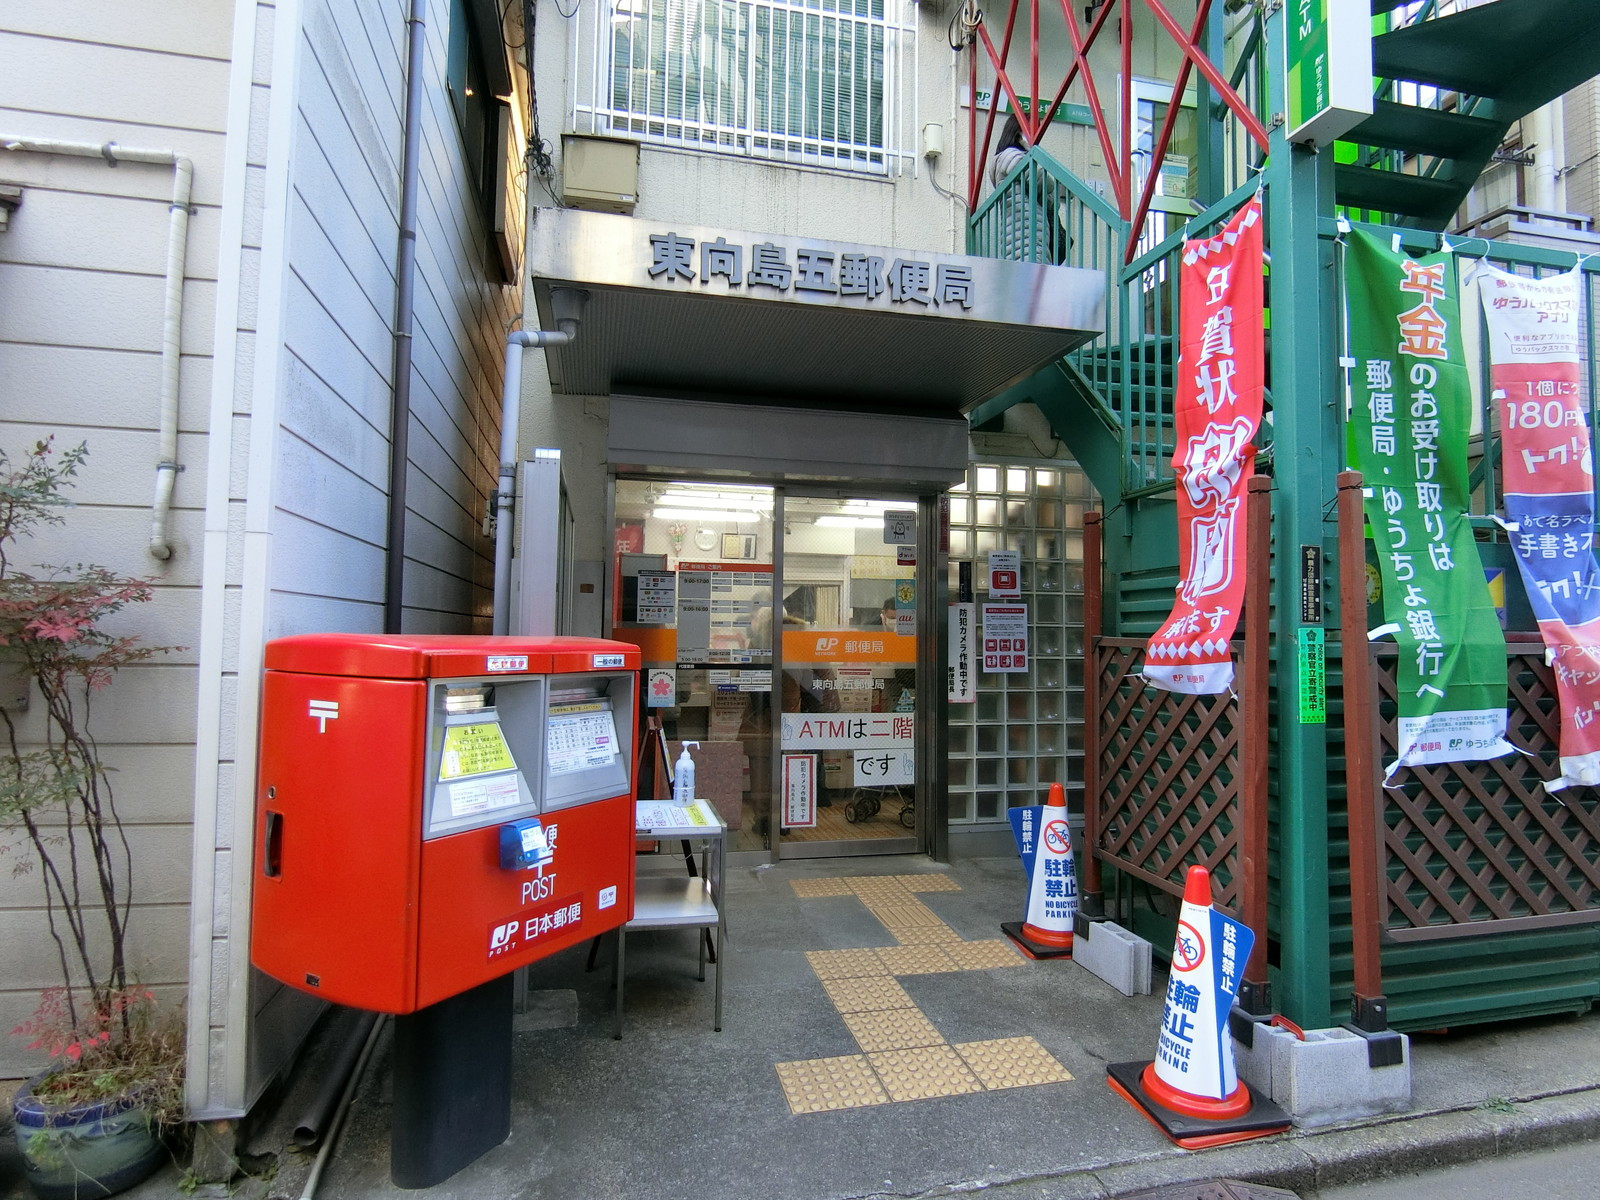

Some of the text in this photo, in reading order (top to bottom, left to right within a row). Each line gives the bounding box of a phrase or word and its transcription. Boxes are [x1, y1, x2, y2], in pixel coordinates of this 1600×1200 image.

[649, 232, 976, 310] 東向島五郵便局
[1194, 263, 1239, 415] 年賀状
[1396, 259, 1454, 572] 年金のお受け取りは
[815, 637, 885, 654] JP 郵便局
[959, 608, 968, 697] 防犯カメラ作動中です
[596, 658, 623, 666] 一般の郵便
[811, 678, 885, 690] 東向島五郵便局
[1307, 643, 1318, 712] 警察官立寄警戒中
[798, 717, 914, 740] ATMは二階
[1420, 741, 1442, 753] 郵便局
[856, 754, 896, 776] です
[1022, 809, 1033, 854] 駐輪禁止
[1044, 858, 1075, 878] 駐輪
[521, 873, 557, 905] POST
[1045, 879, 1078, 899] 禁止
[1045, 900, 1079, 909] NO BICYCLE
[490, 901, 581, 949] JP 日本郵便
[488, 942, 517, 958] POST
[1220, 922, 1237, 996] 駐輪禁止
